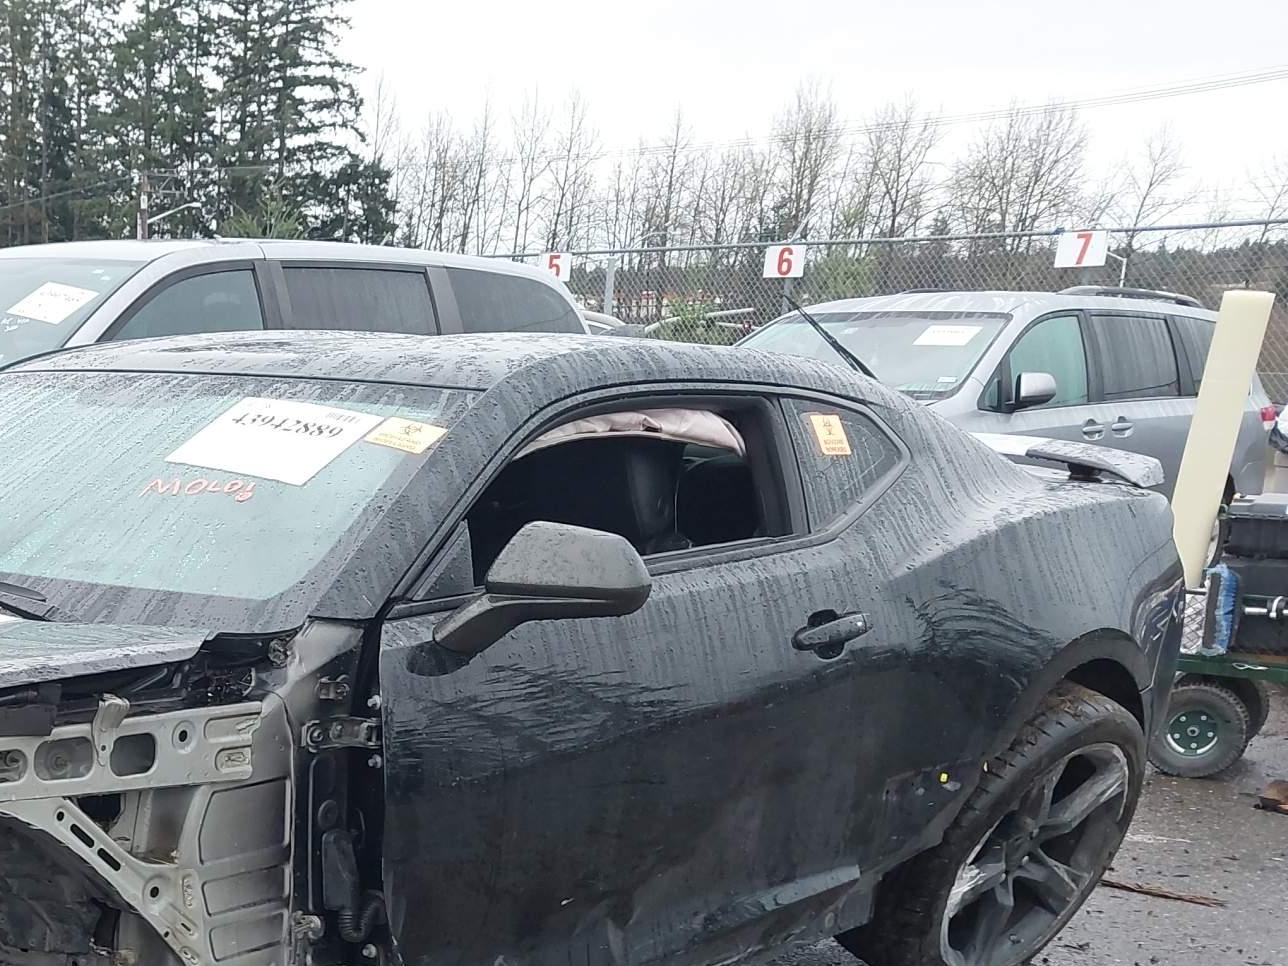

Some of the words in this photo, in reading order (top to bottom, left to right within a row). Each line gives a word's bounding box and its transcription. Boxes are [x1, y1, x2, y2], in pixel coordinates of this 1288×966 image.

[777, 246, 794, 276] 6
[1075, 233, 1093, 265] 7
[549, 254, 561, 277] 5
